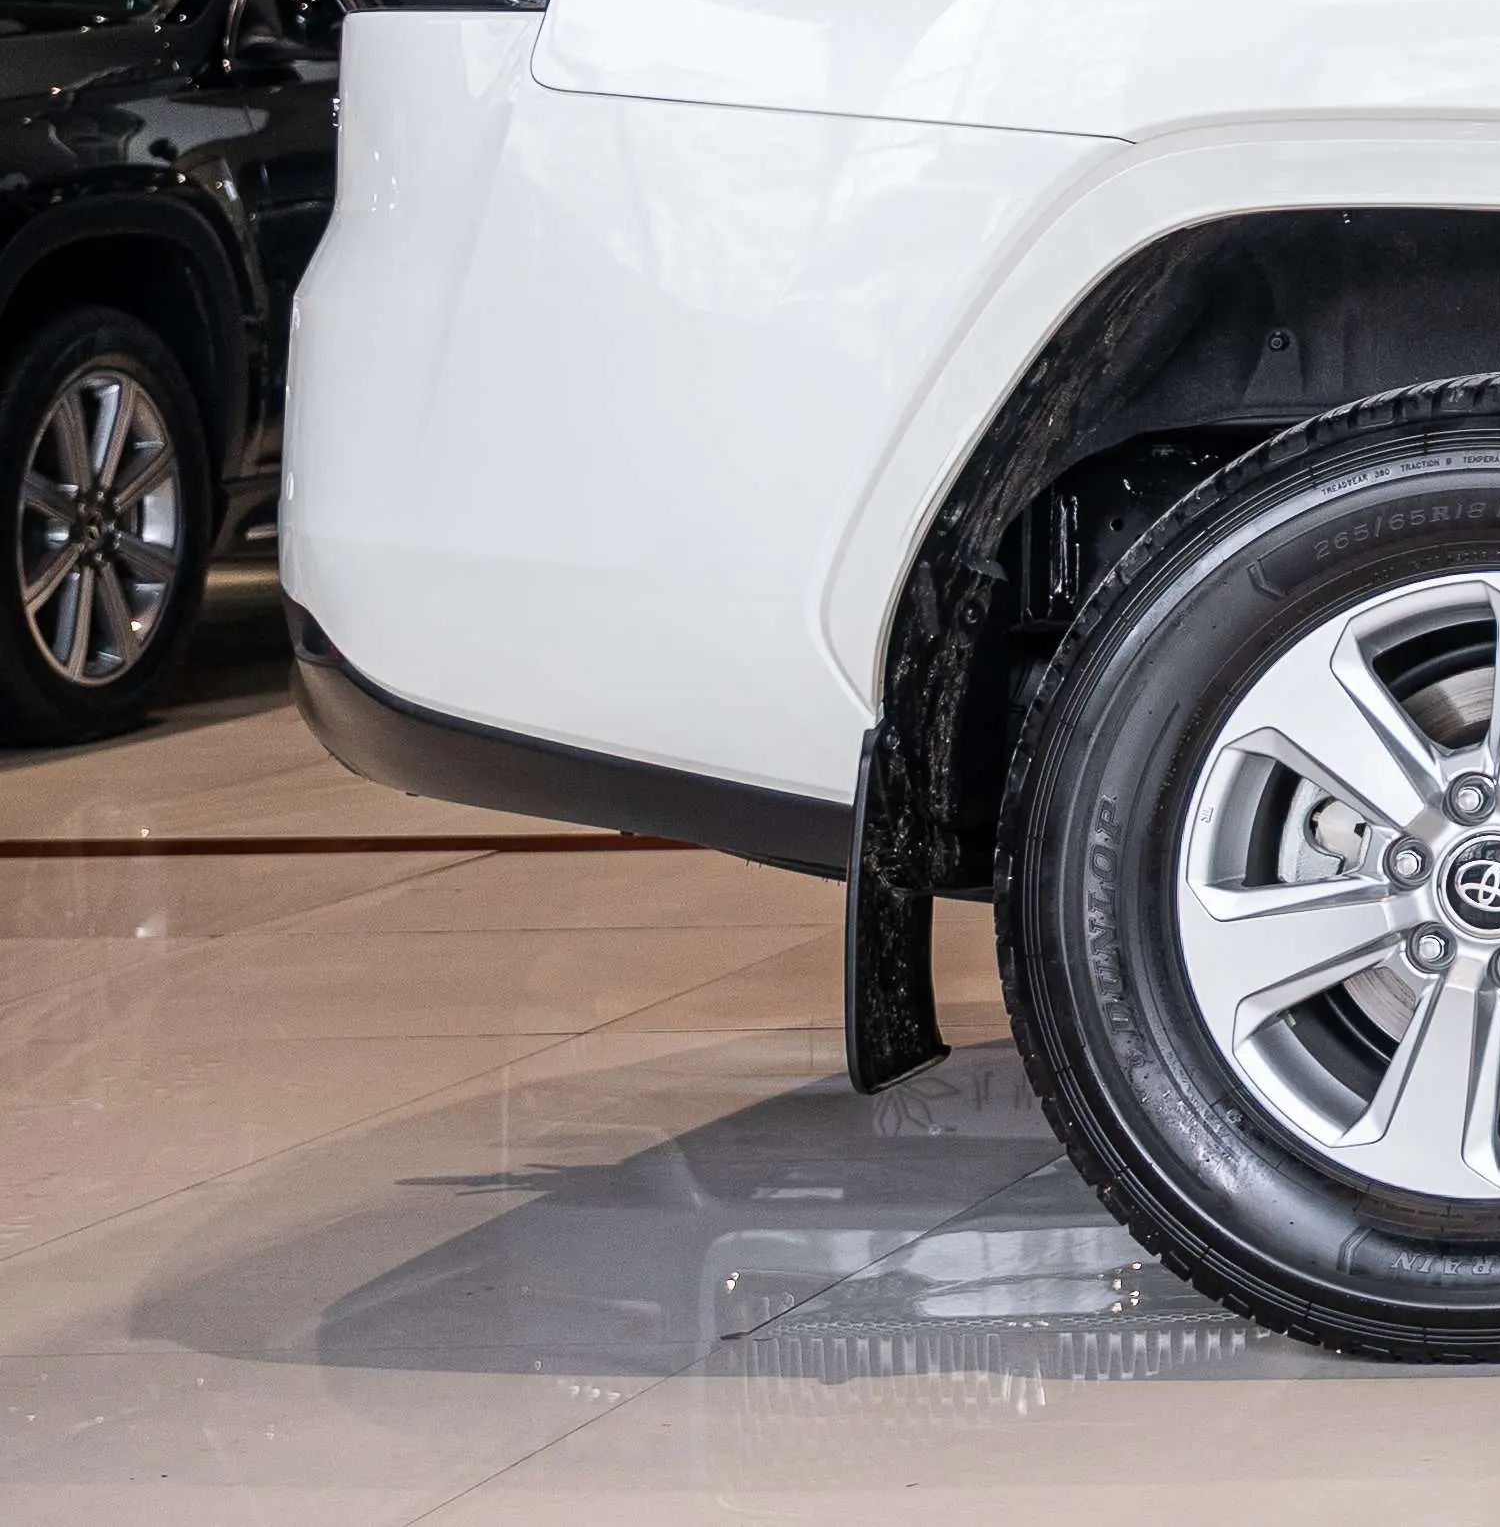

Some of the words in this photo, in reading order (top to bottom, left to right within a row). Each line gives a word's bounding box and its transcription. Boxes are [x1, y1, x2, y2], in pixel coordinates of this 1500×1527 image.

[1401, 458, 1441, 473] TRACTION
[1313, 501, 1486, 561] 265/65R18
[1086, 793, 1146, 1044] DUNLOP
